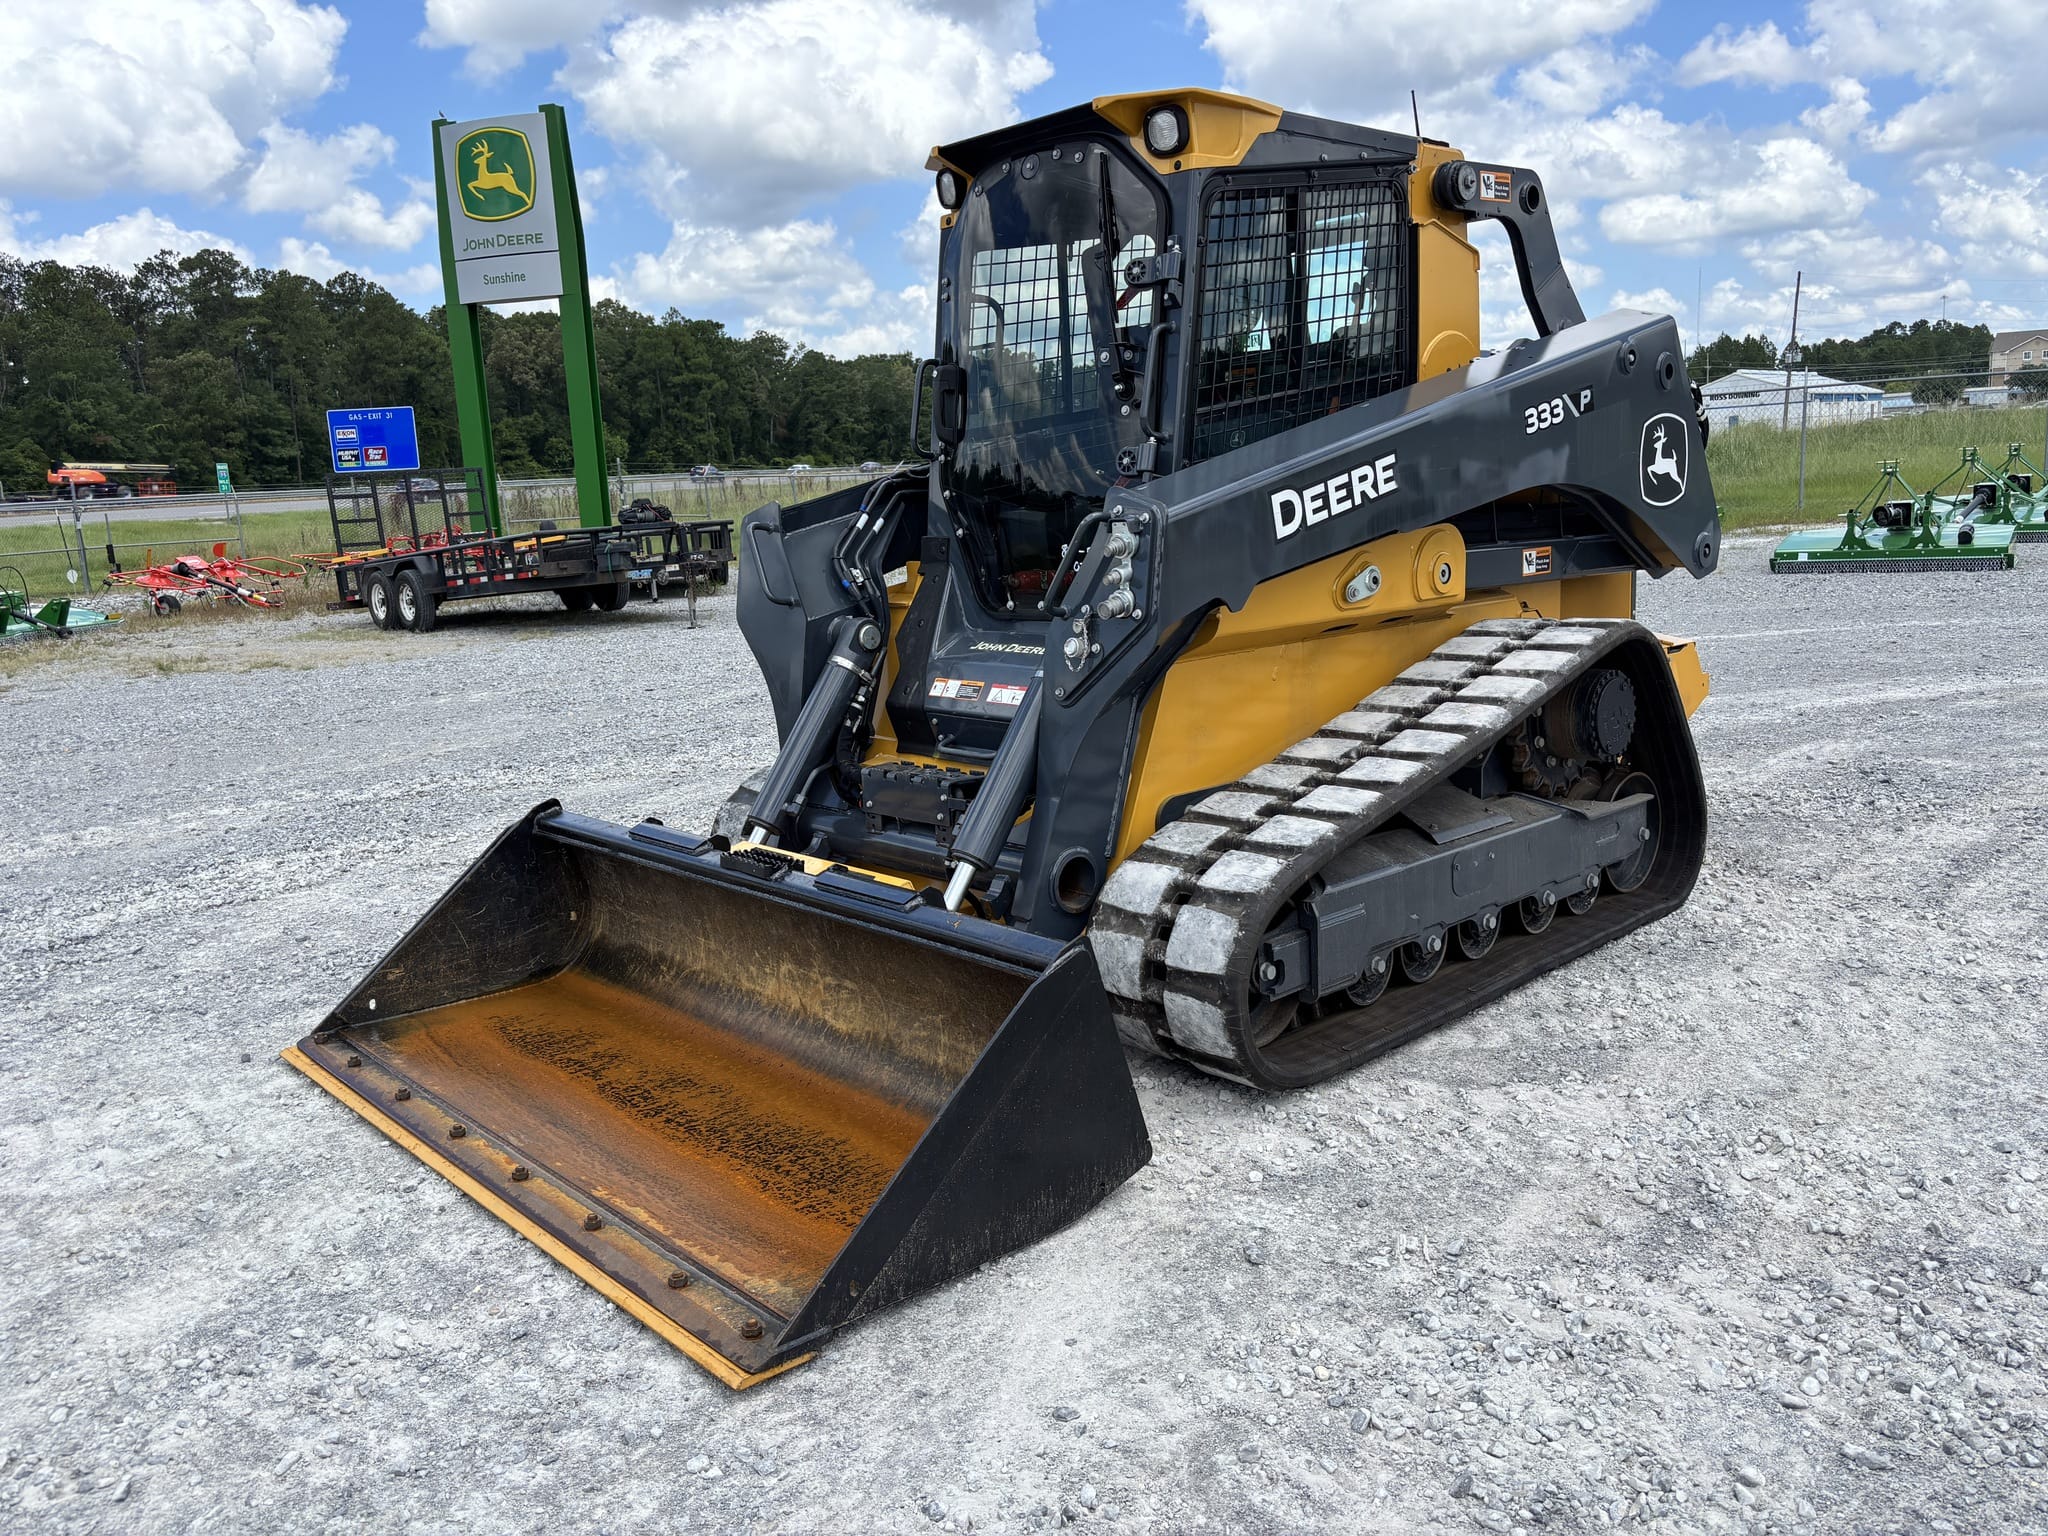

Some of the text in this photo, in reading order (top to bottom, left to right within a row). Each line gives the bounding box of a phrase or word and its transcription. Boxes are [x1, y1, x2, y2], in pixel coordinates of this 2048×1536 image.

[463, 232, 544, 252] JOHN DEERE
[483, 271, 527, 286] Sunshine
[1271, 453, 1399, 540] DEERE
[969, 641, 1005, 652] JOHN
